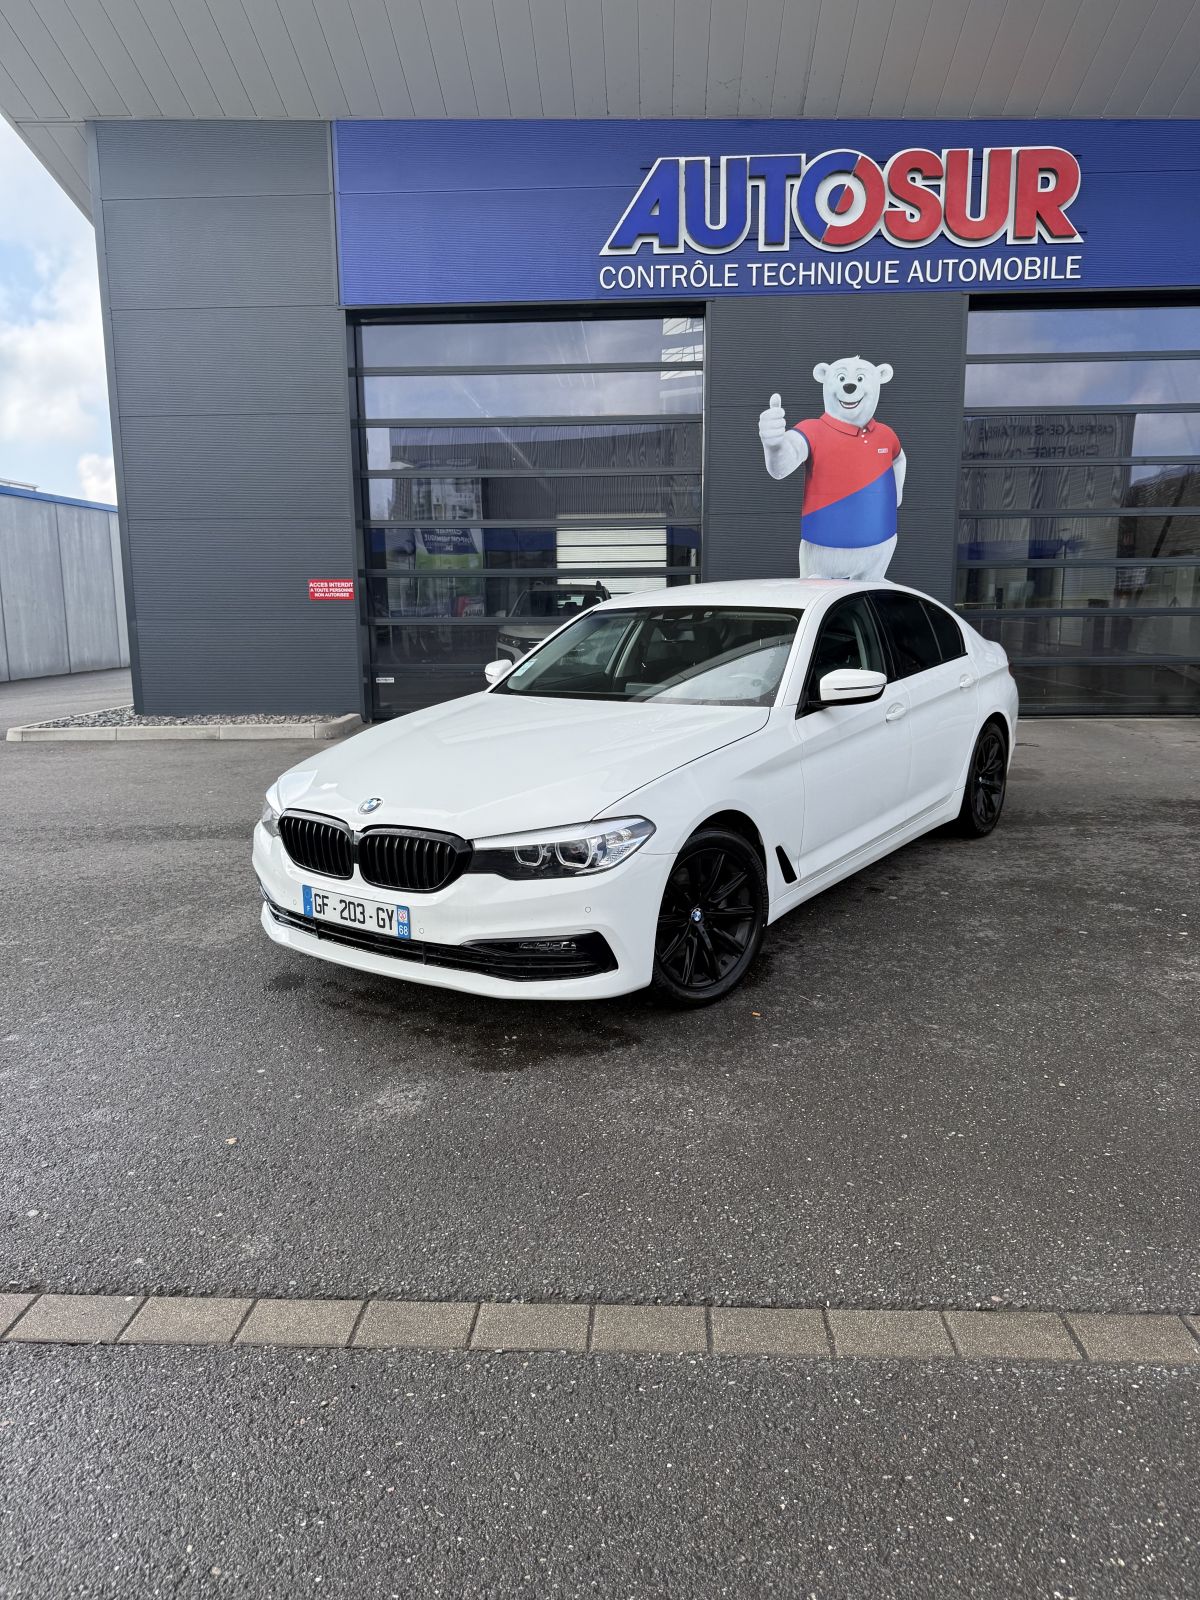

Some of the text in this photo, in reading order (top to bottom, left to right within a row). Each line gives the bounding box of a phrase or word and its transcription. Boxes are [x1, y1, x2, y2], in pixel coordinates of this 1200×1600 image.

[600, 146, 1083, 255] AUTOSUR
[599, 255, 1082, 289] CONTRÔLE TECHNIQUE AUTOMOBILE
[398, 924, 409, 936] 68
